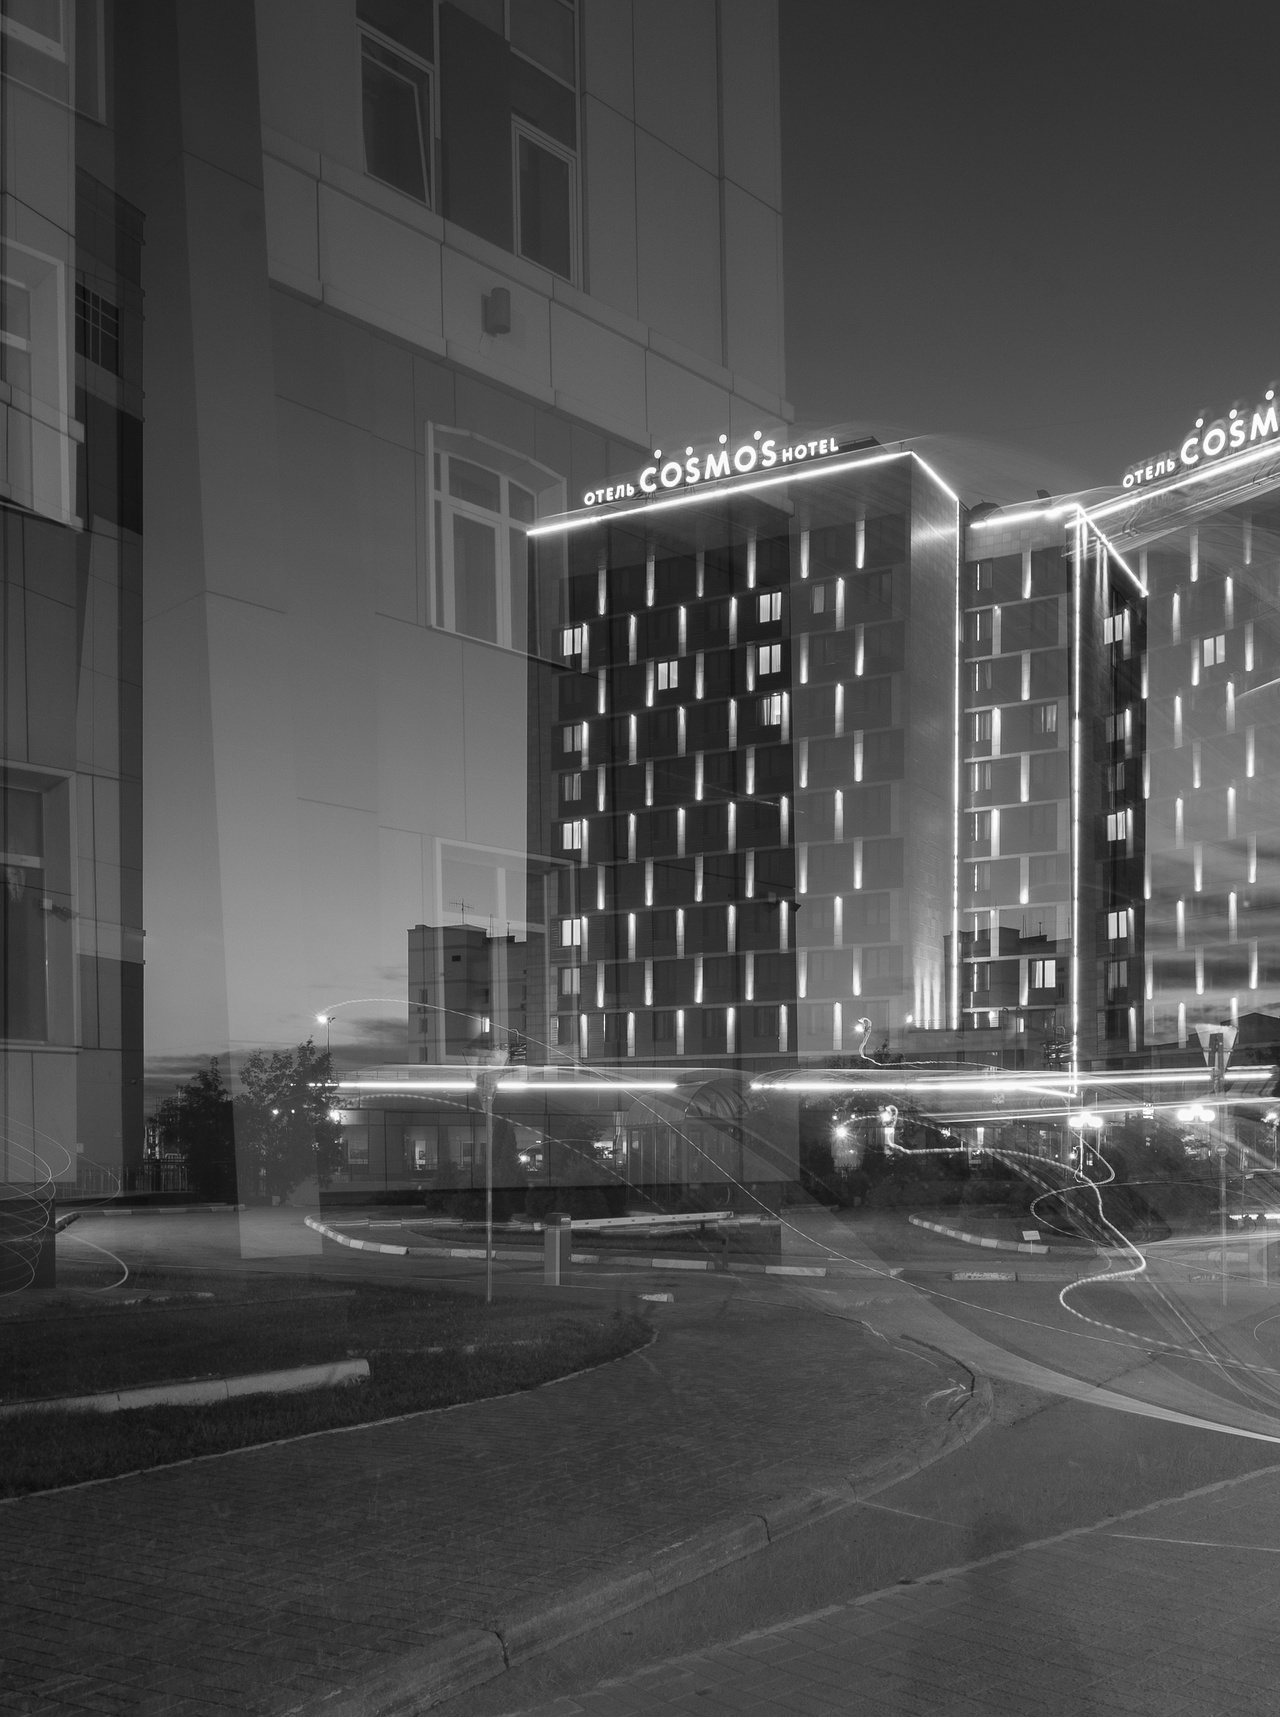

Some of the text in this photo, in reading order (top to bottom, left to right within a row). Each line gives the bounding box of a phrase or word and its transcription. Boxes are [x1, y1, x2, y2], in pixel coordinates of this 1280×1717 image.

[583, 437, 839, 506] ОТЕЛЬ COSMOS HOTEL
[1122, 458, 1176, 488] ОТЕЛЬ
